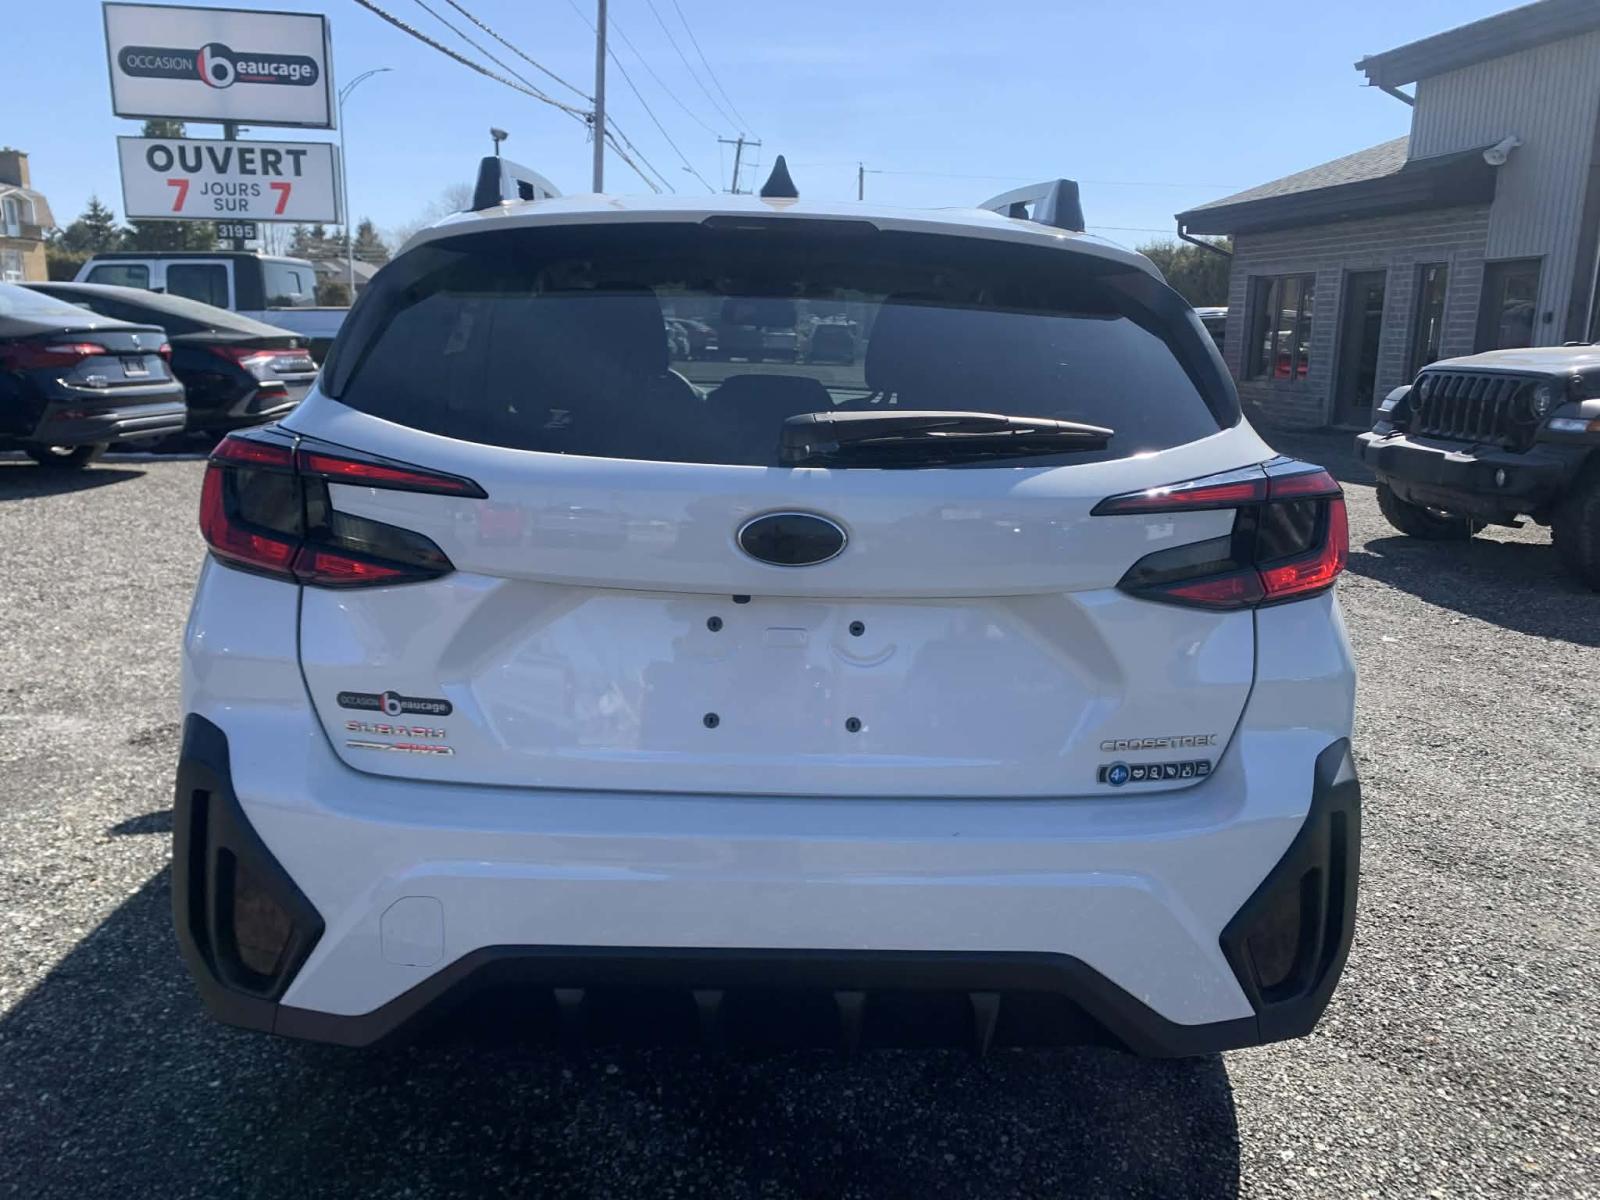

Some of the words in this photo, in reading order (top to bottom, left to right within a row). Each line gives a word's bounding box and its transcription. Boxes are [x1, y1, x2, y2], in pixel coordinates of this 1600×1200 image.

[126, 54, 193, 71] OCCASION
[200, 45, 312, 88] beaucage
[146, 144, 308, 177] OUVERT
[167, 178, 190, 212] 7
[200, 182, 261, 197] JOURS
[269, 181, 292, 215] 7
[213, 198, 249, 212] SUR
[218, 224, 254, 239] 3195
[345, 720, 446, 738] SUBARU
[1100, 734, 1218, 752] CROSSTREK
